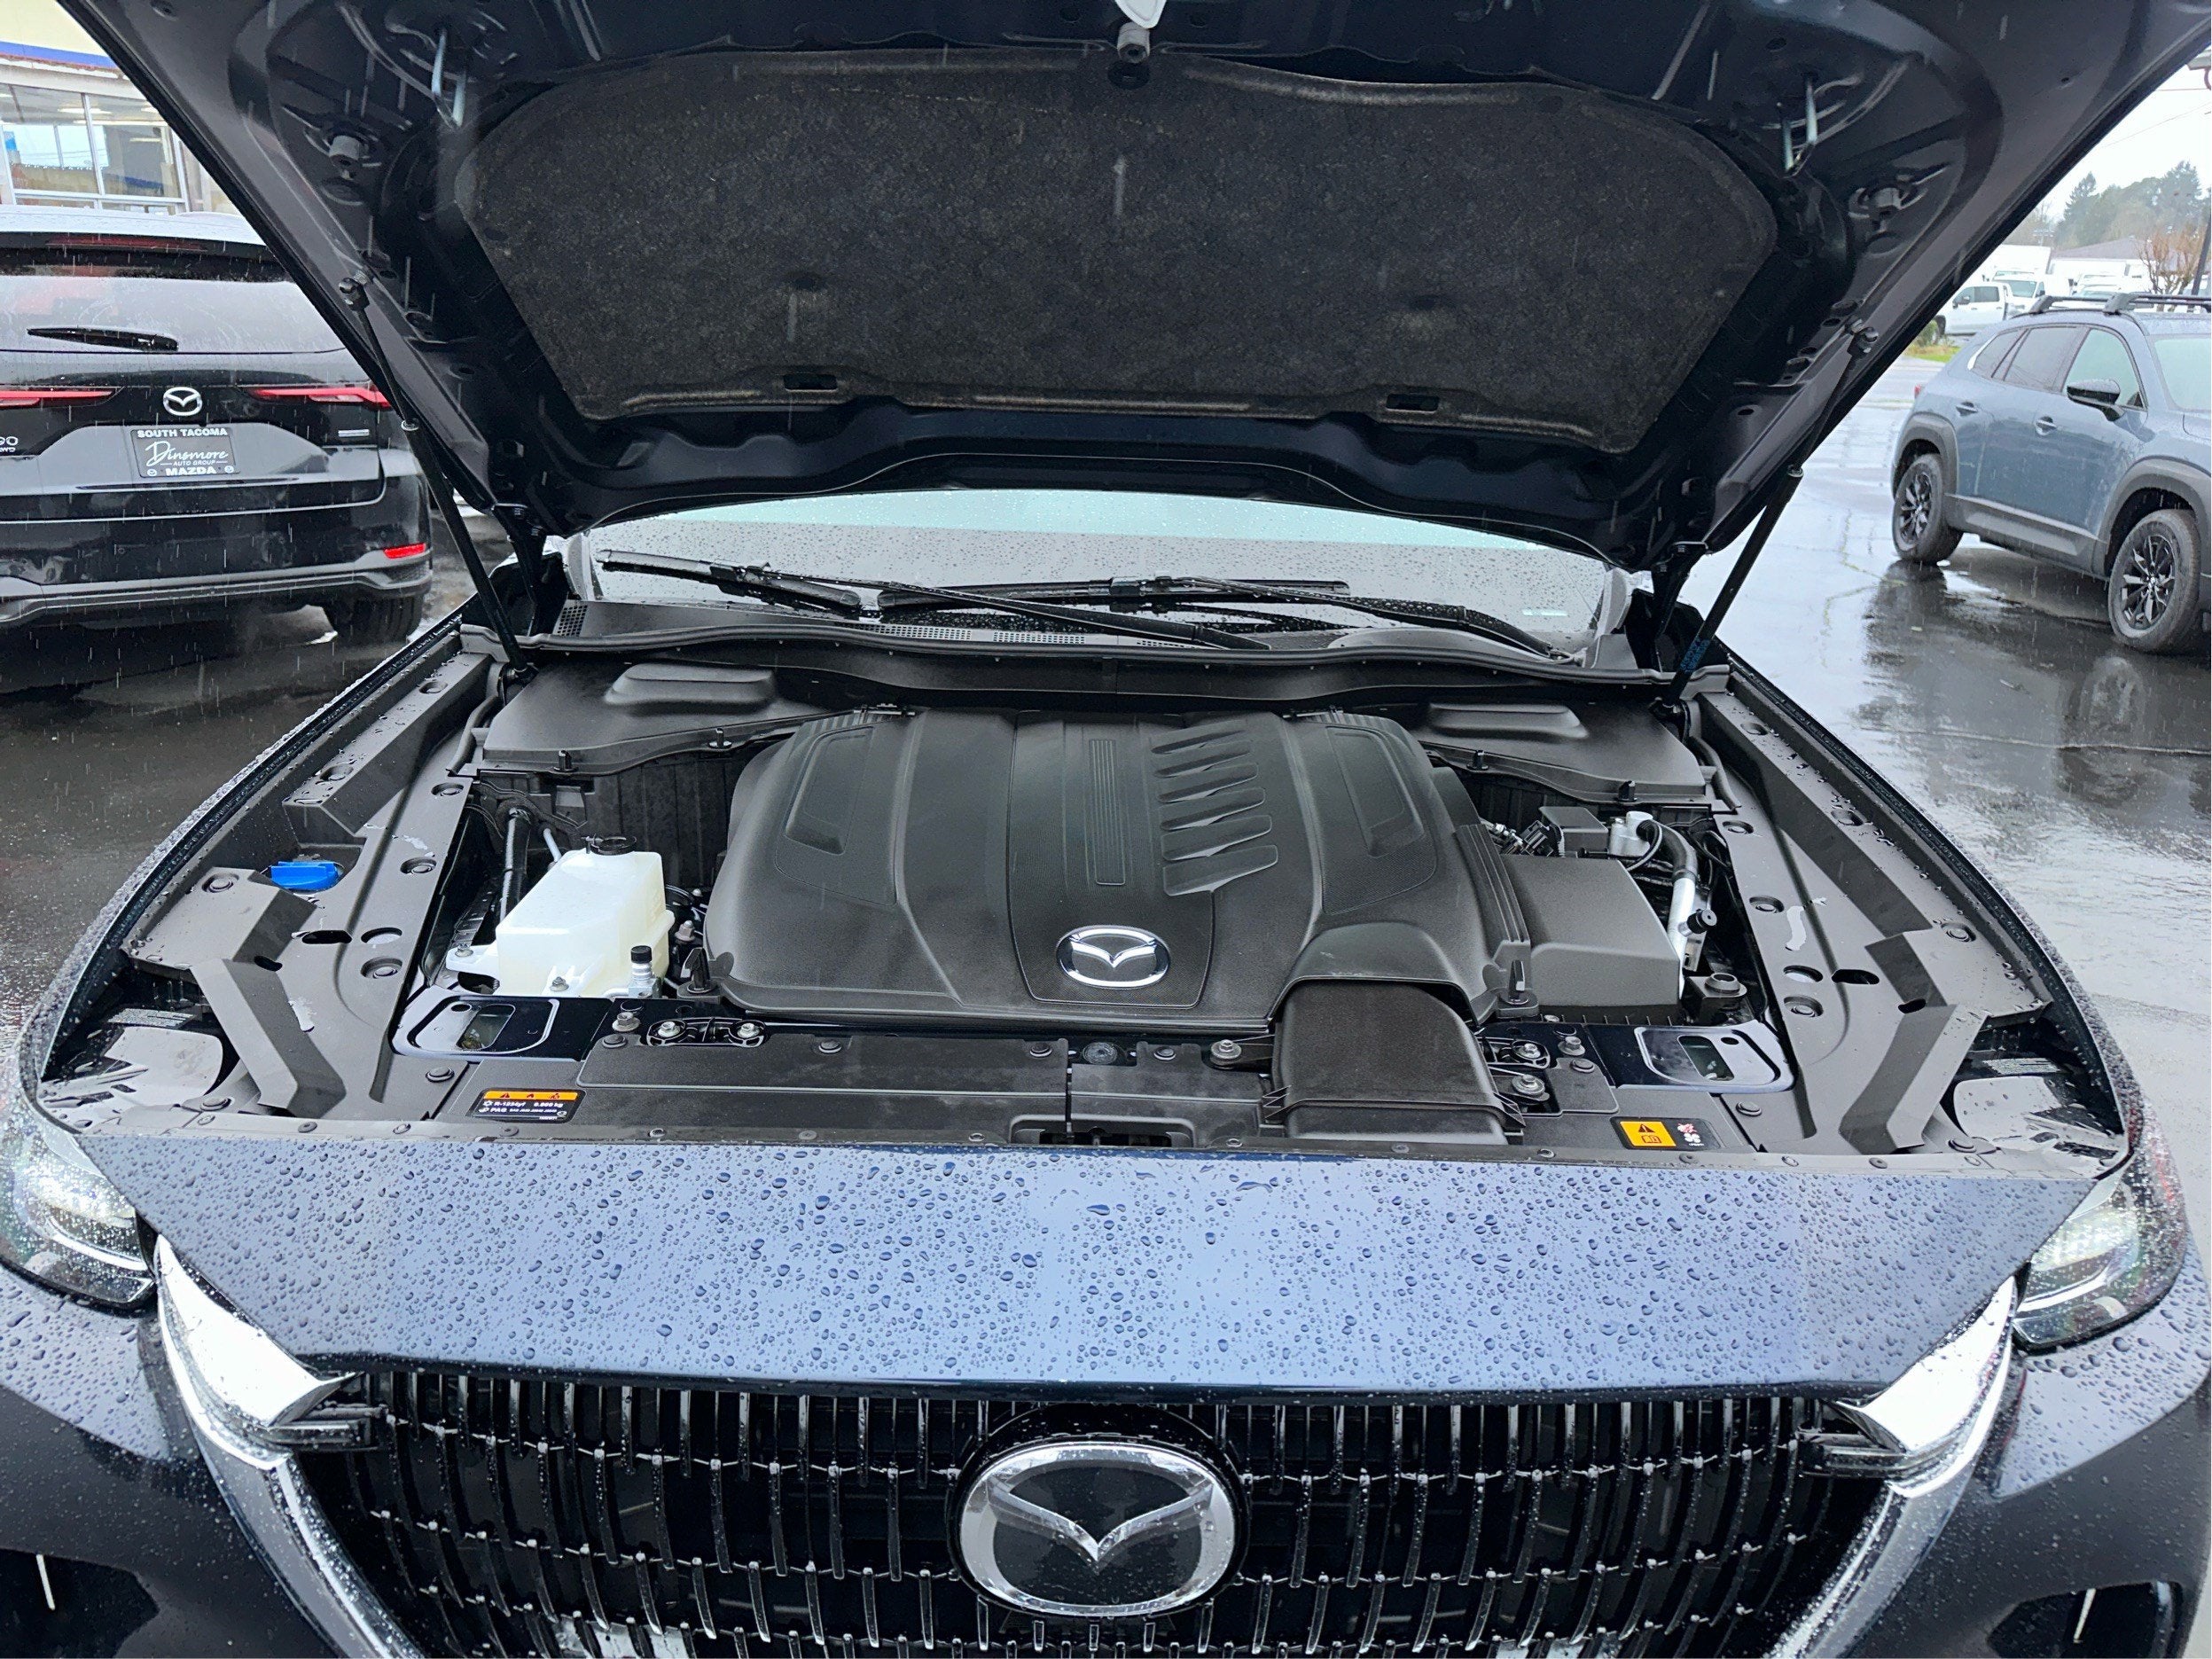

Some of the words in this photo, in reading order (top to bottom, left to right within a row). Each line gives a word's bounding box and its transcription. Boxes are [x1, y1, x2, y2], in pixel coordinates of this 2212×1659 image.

[137, 429, 178, 438] SOUTH
[180, 427, 228, 437] TACOMA
[145, 440, 229, 467] Dinsmore
[165, 466, 217, 476] MAZDA
